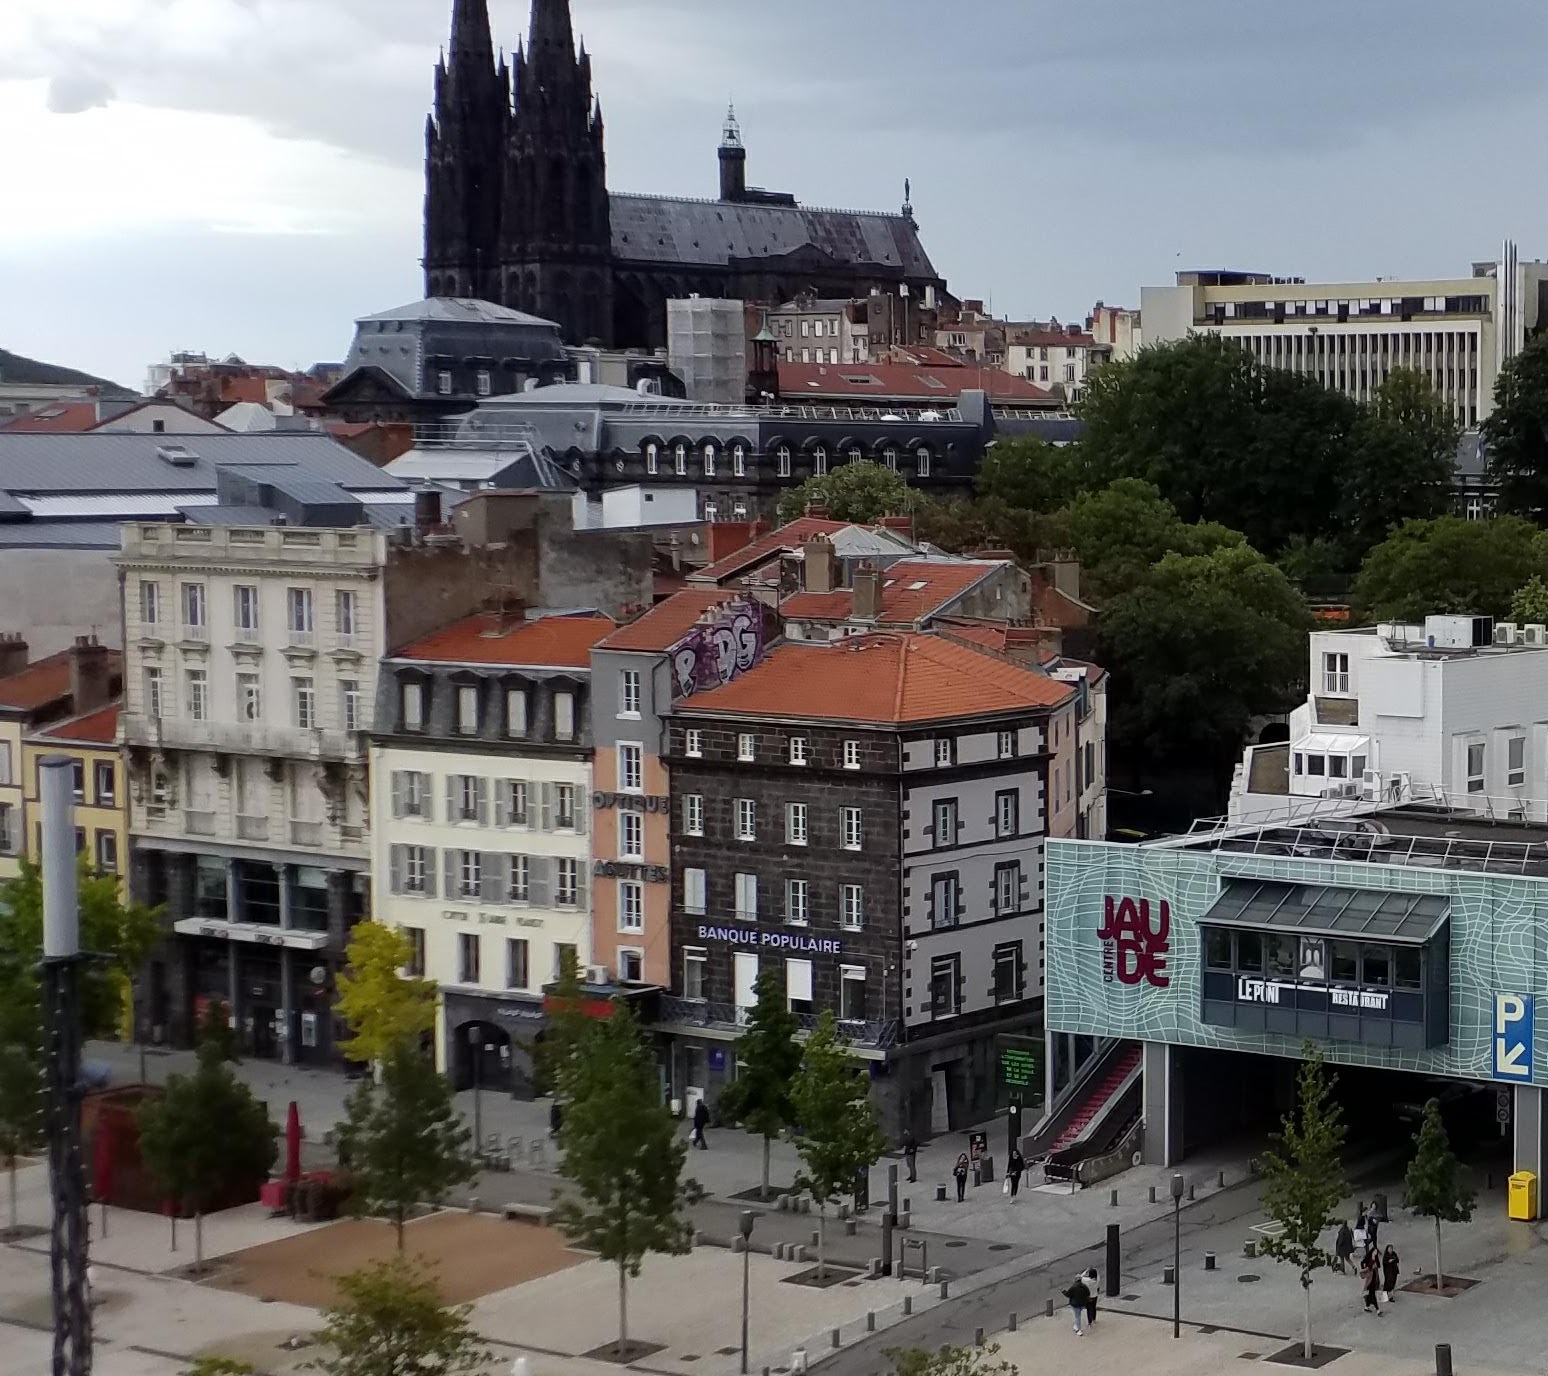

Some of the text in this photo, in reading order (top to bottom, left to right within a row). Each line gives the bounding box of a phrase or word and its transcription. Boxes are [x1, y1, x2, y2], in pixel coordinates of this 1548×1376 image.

[593, 791, 669, 814] OPTIQUE
[698, 925, 841, 954] BANQUE POPULAIRE
[1103, 941, 1114, 982] CENTRE
[1238, 978, 1253, 1001] LE
[1496, 994, 1525, 1034] P
